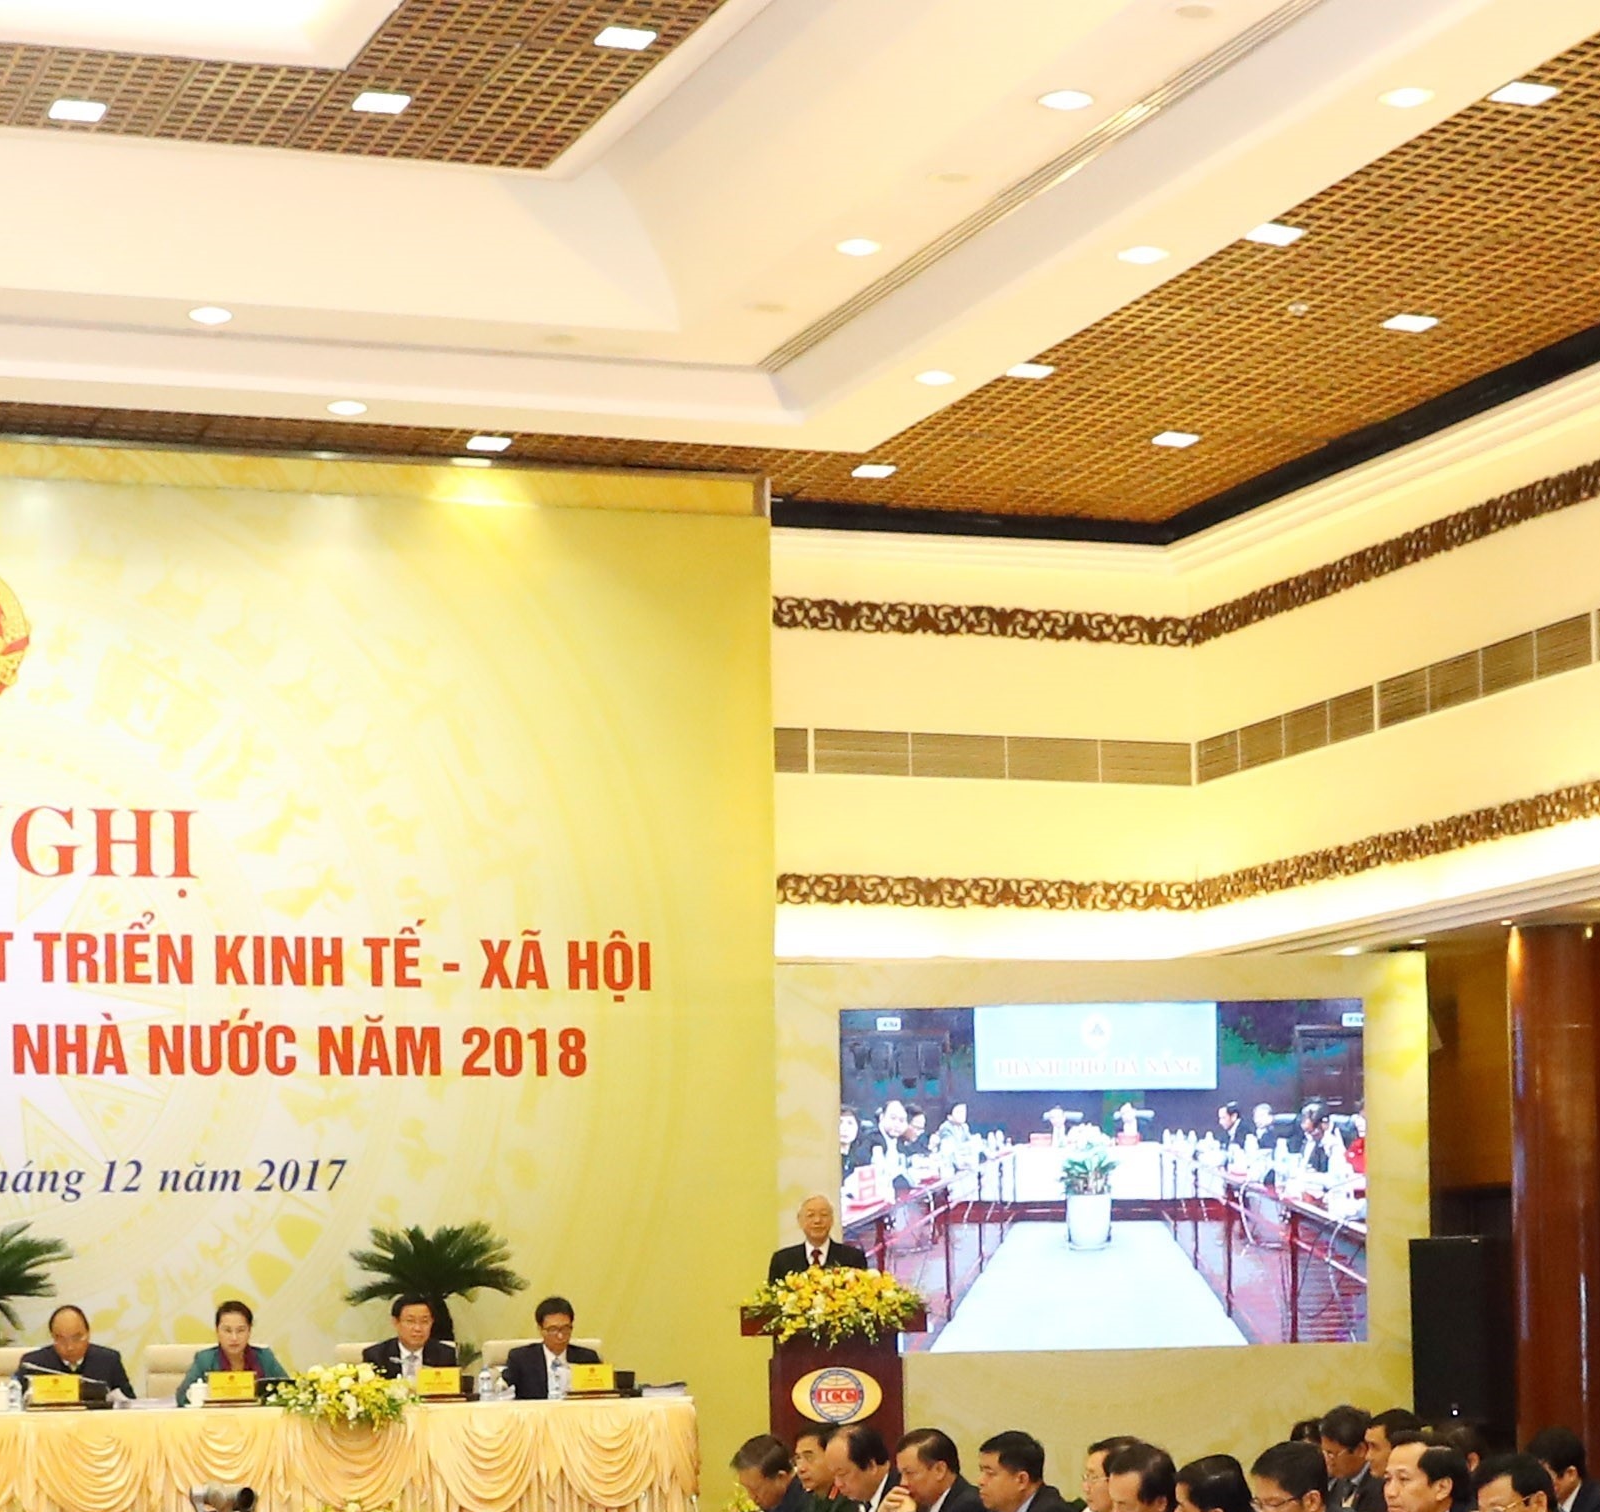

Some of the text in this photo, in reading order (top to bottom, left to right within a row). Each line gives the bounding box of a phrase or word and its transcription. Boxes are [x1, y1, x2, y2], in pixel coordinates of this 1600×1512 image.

[33, 911, 194, 985] TRIỂN
[215, 935, 344, 987] KINH
[363, 917, 424, 988] TẾ
[480, 929, 549, 990] XÃ
[567, 929, 652, 1003] HỘI
[12, 1012, 128, 1076] NHÀ
[148, 1009, 297, 1077] NƯỚC
[318, 1017, 442, 1077] NĂM
[462, 1026, 588, 1079] 2018
[102, 1160, 142, 1193] 12
[159, 1163, 241, 1192] năm
[255, 1159, 347, 1192] 2017
[820, 1389, 856, 1403] ICC
